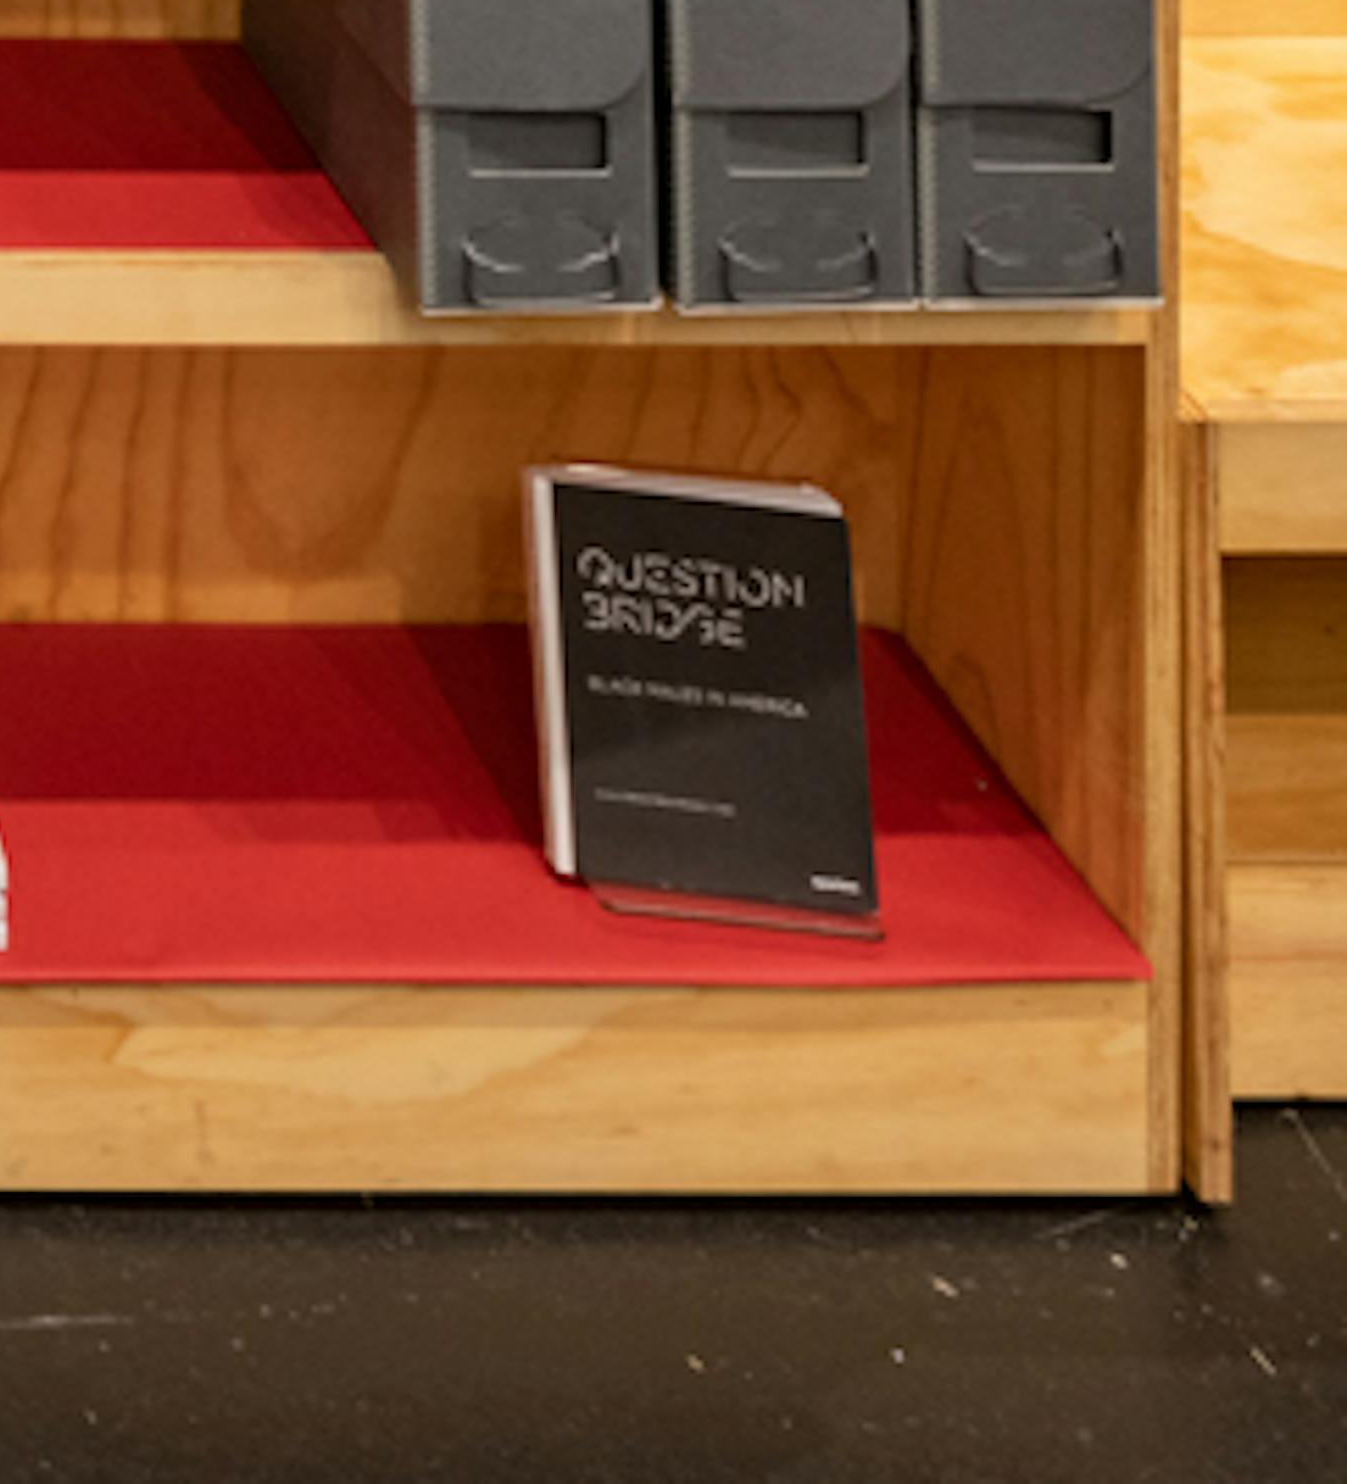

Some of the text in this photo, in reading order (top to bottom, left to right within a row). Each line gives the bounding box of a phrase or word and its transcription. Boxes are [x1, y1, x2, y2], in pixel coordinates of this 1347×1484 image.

[575, 545, 806, 609] QUESTION
[582, 590, 747, 651] BRIDGE
[587, 673, 810, 720] BLACK MALES IN AMERICA
